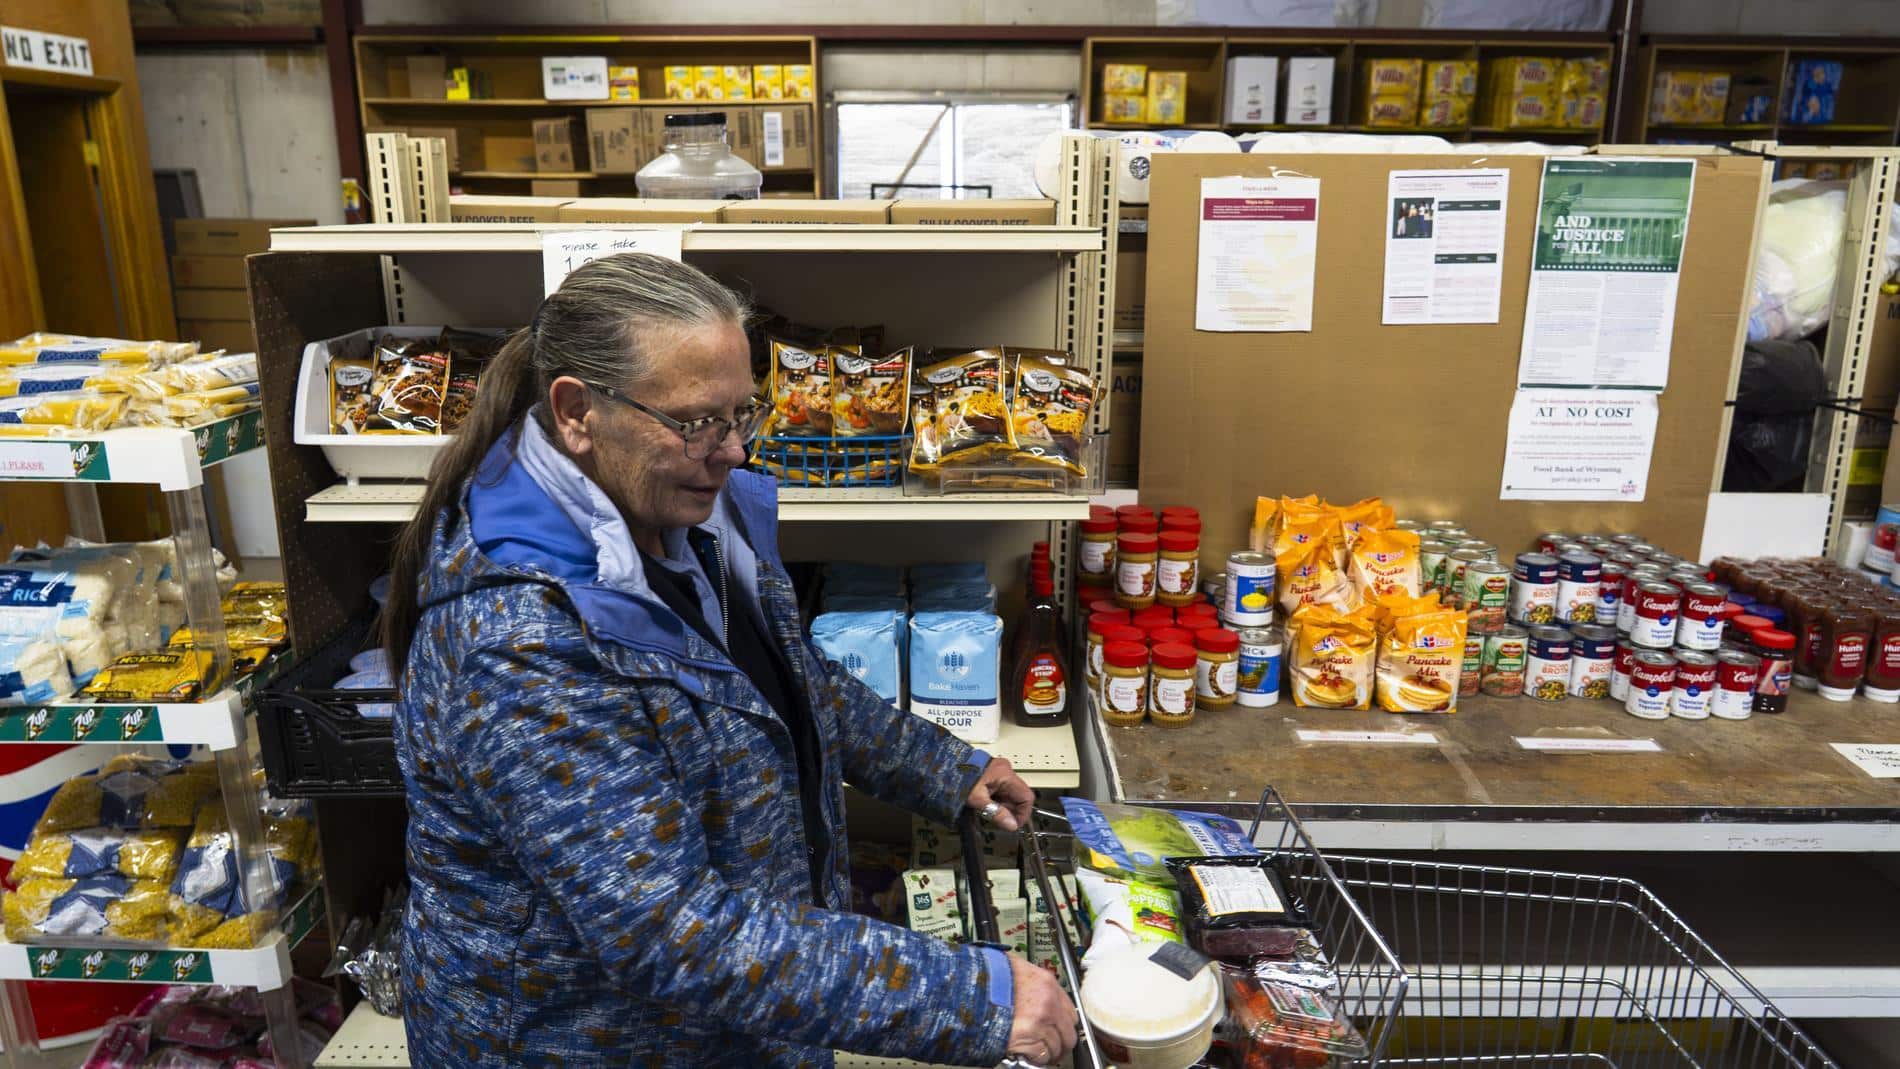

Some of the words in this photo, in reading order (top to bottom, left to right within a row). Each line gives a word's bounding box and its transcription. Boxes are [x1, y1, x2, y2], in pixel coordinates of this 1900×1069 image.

[4, 32, 33, 62] NO
[43, 39, 88, 69] EXIT
[1554, 215, 1591, 228] AND
[1552, 229, 1625, 242] JUSTICE
[609, 238, 638, 249] take
[1570, 242, 1602, 255] ALL
[1536, 407, 1556, 418] AT
[1566, 407, 1588, 418] NO
[1595, 407, 1634, 418] COST
[12, 588, 47, 602] RIC
[1406, 655, 1452, 666] Pancake
[1320, 663, 1342, 675] Mix
[1416, 667, 1440, 676] Mix
[26, 708, 47, 727] 7UP
[74, 708, 95, 727] 7UP
[122, 708, 143, 727] 7UP
[928, 708, 983, 717] ALL-PURPOSE
[936, 717, 972, 727] FLOUR
